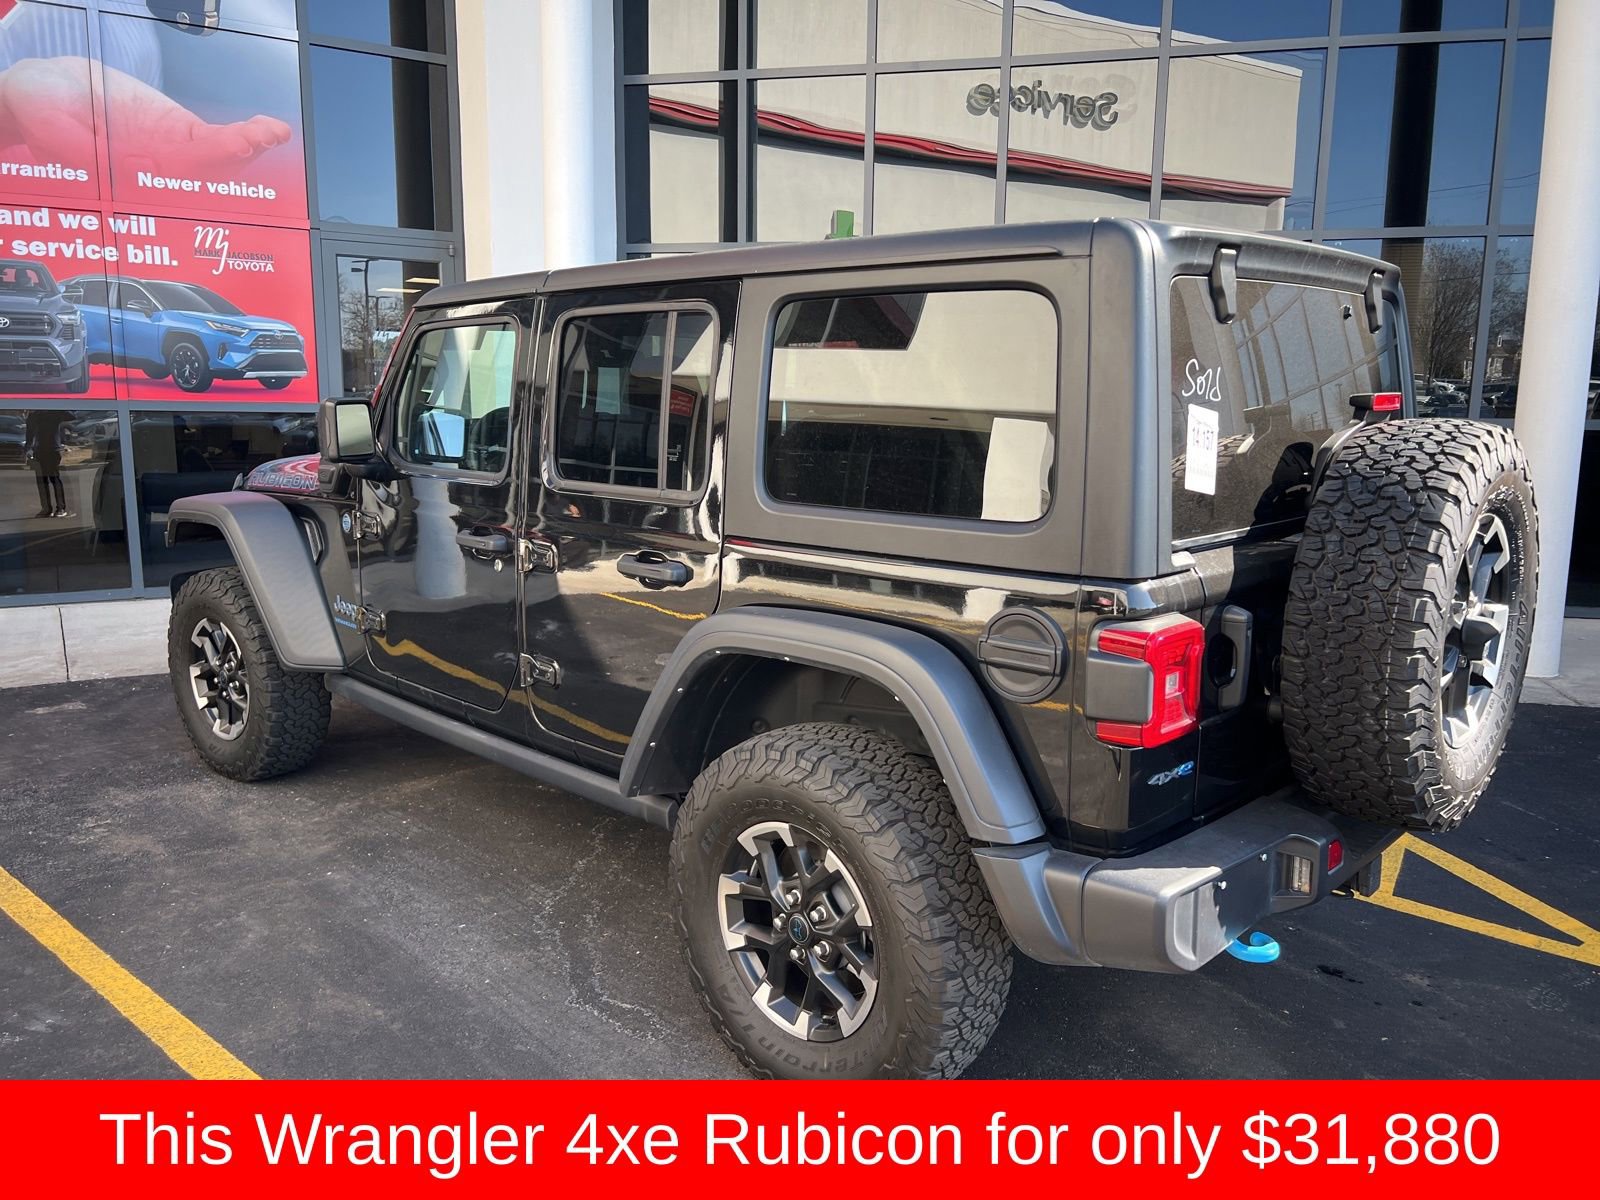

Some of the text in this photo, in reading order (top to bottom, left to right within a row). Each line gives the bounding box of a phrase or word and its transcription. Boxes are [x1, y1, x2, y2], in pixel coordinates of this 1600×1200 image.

[1, 162, 89, 182] rranties
[137, 171, 277, 200] Newer vehicle
[0, 208, 157, 237] and we will
[11, 239, 179, 267] service bill.
[227, 260, 275, 273] TOYOTA
[247, 472, 317, 491] RUBICON
